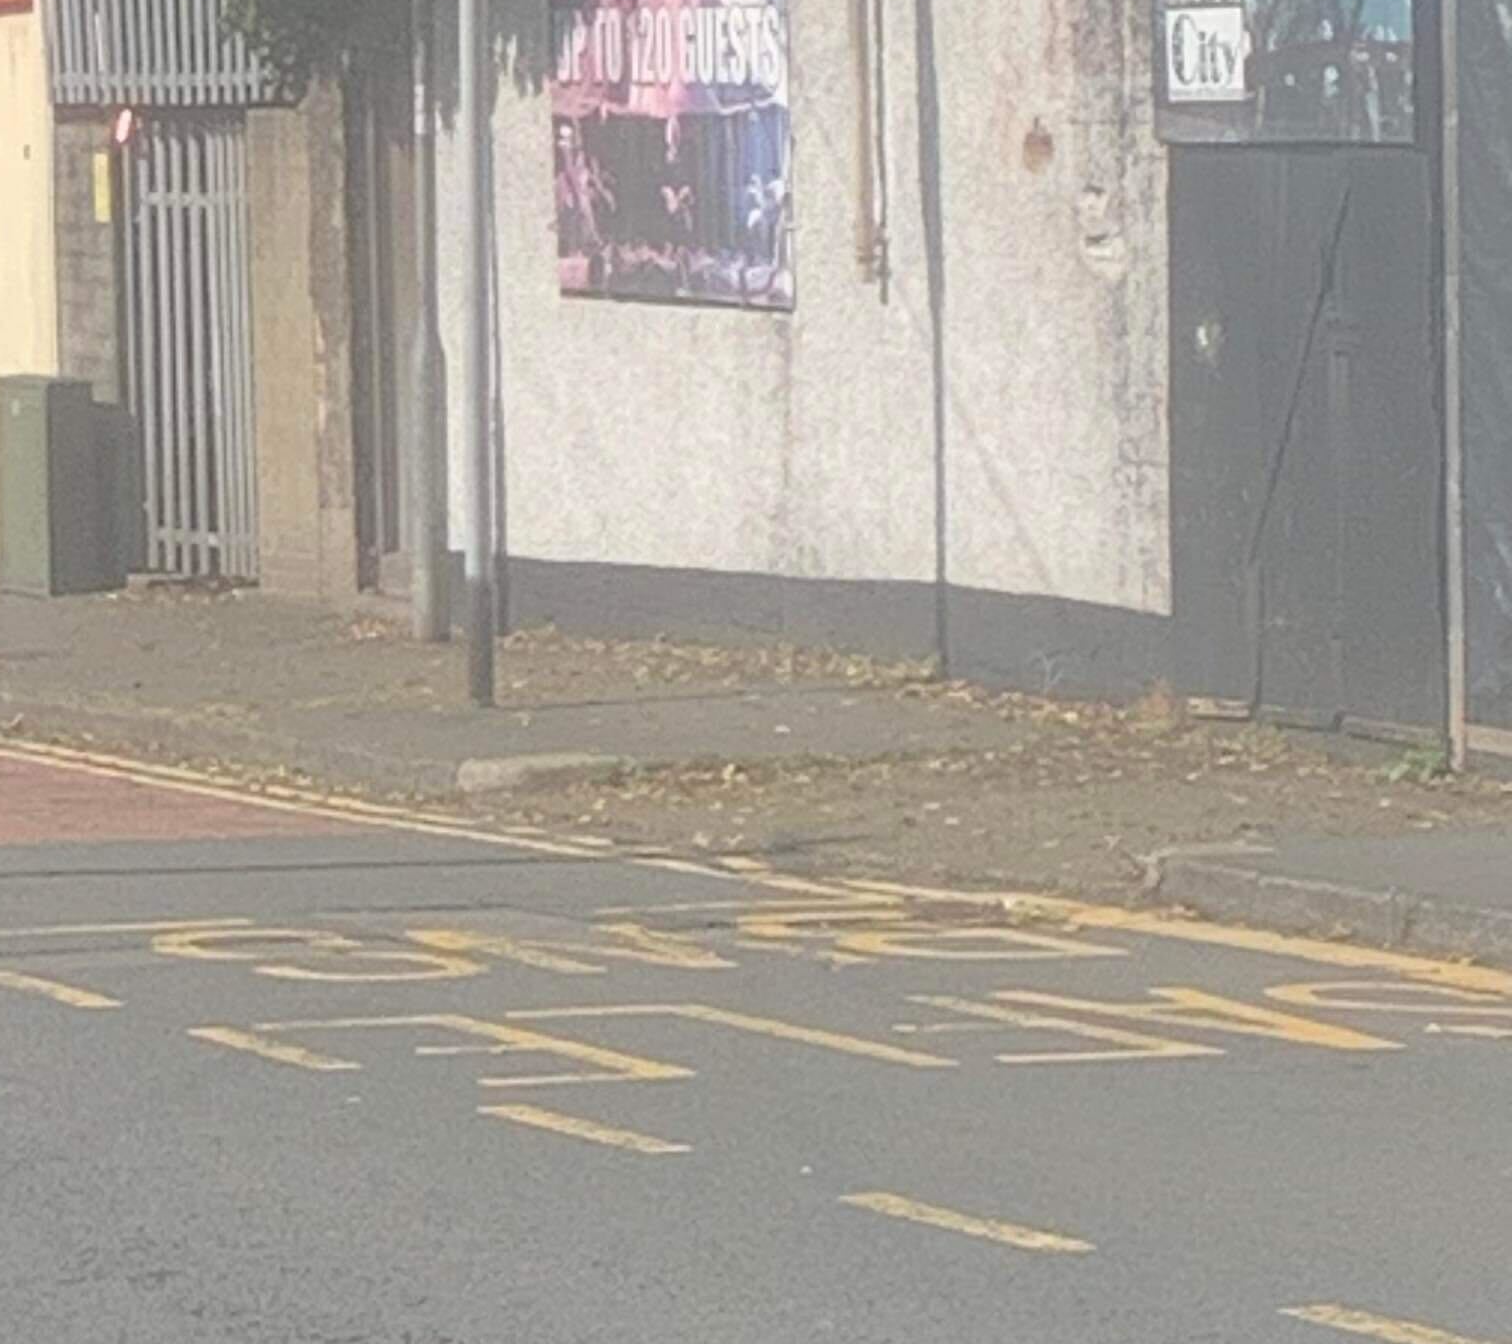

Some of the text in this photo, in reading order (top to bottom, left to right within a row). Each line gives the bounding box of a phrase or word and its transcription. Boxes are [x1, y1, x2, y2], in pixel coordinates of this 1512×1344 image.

[594, 7, 622, 84] TO
[628, 7, 673, 84] 120
[679, 5, 780, 90] GUESTS
[1172, 13, 1238, 87] City
